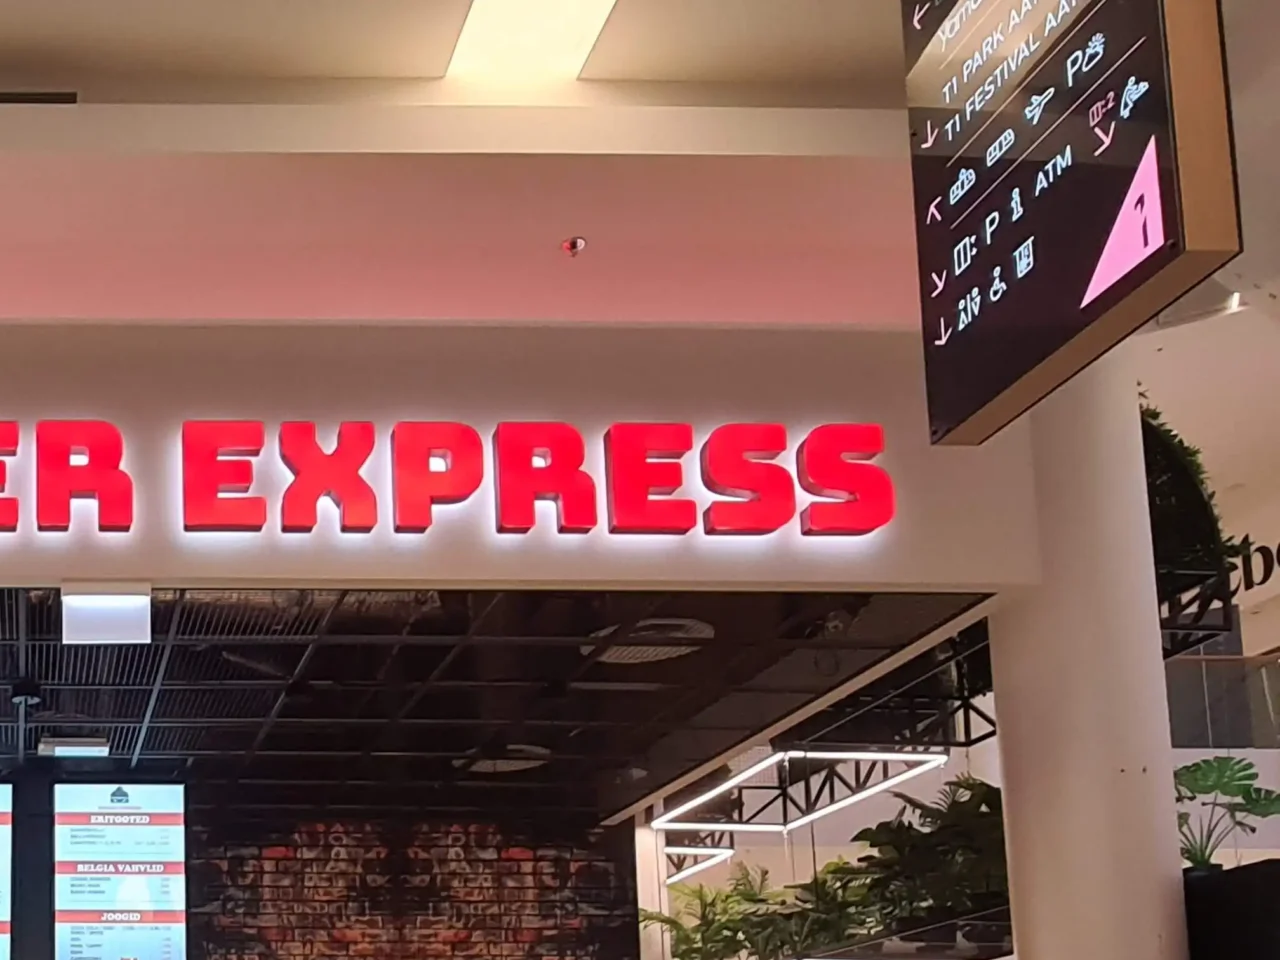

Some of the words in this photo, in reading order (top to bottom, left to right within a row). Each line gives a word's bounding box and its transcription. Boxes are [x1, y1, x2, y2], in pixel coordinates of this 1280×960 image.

[942, 76, 957, 103] T1
[962, 22, 1005, 83] PARK
[1008, 0, 1037, 33] AA
[945, 113, 960, 141] T1
[965, 32, 1040, 121] FESTIVAL
[1044, 0, 1076, 37] AA
[1034, 145, 1072, 197] ATM
[180, 420, 896, 536] EXPRESS
[77, 864, 115, 872] BELGIA
[117, 864, 164, 872] VAHVLID
[100, 912, 141, 921] JOOGID
